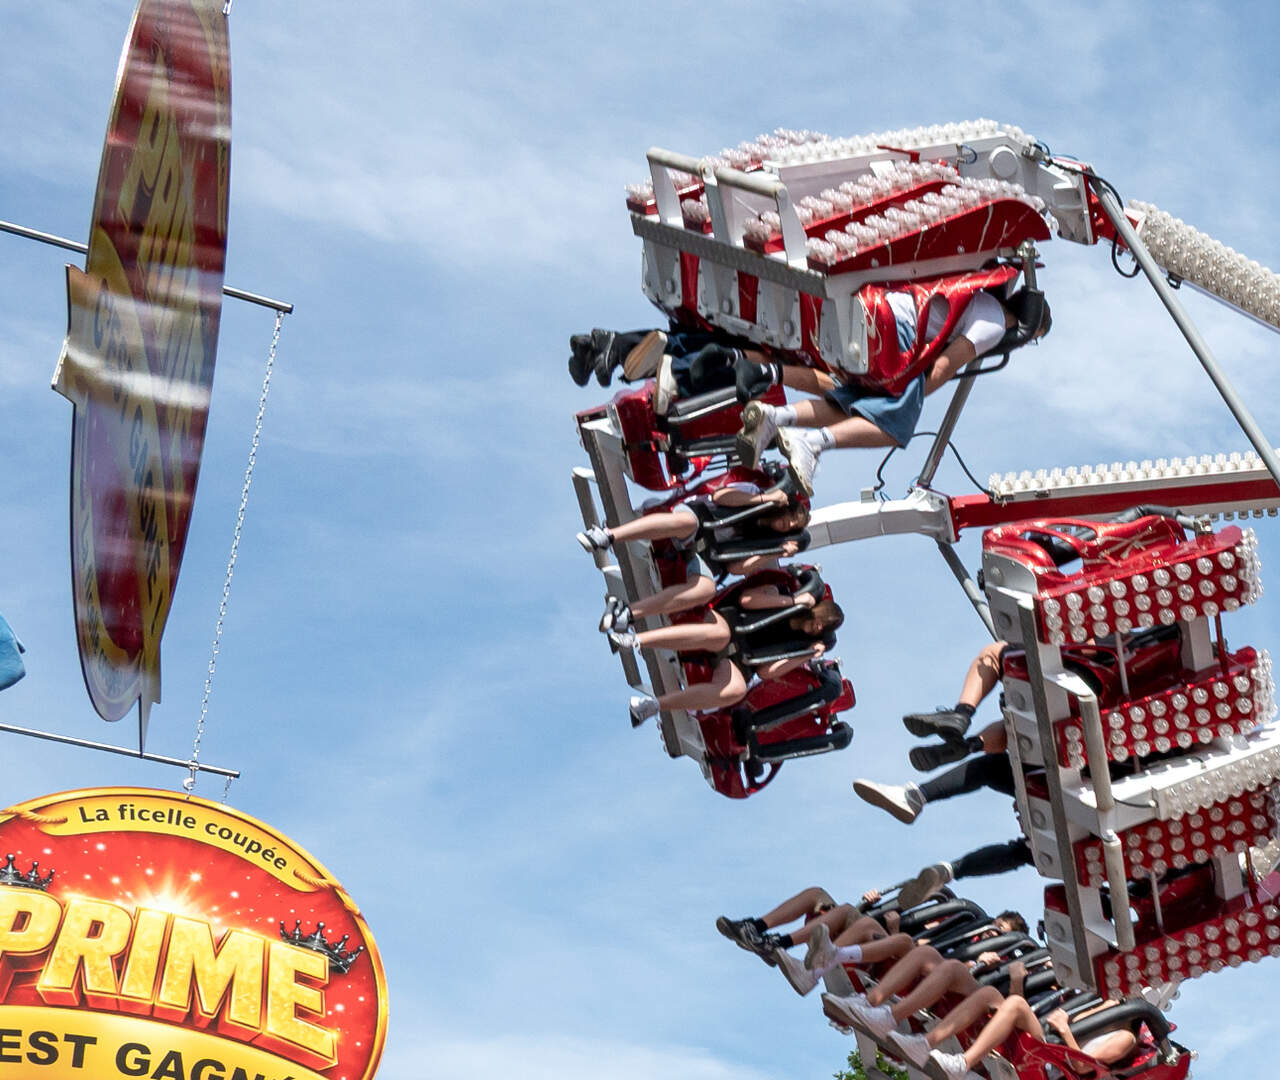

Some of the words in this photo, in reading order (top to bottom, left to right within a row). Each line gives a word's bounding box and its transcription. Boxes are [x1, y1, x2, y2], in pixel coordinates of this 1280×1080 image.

[78, 805, 109, 823] La
[118, 803, 197, 829] ficelle
[205, 821, 288, 870] coupée
[0, 888, 339, 1069] PRIME
